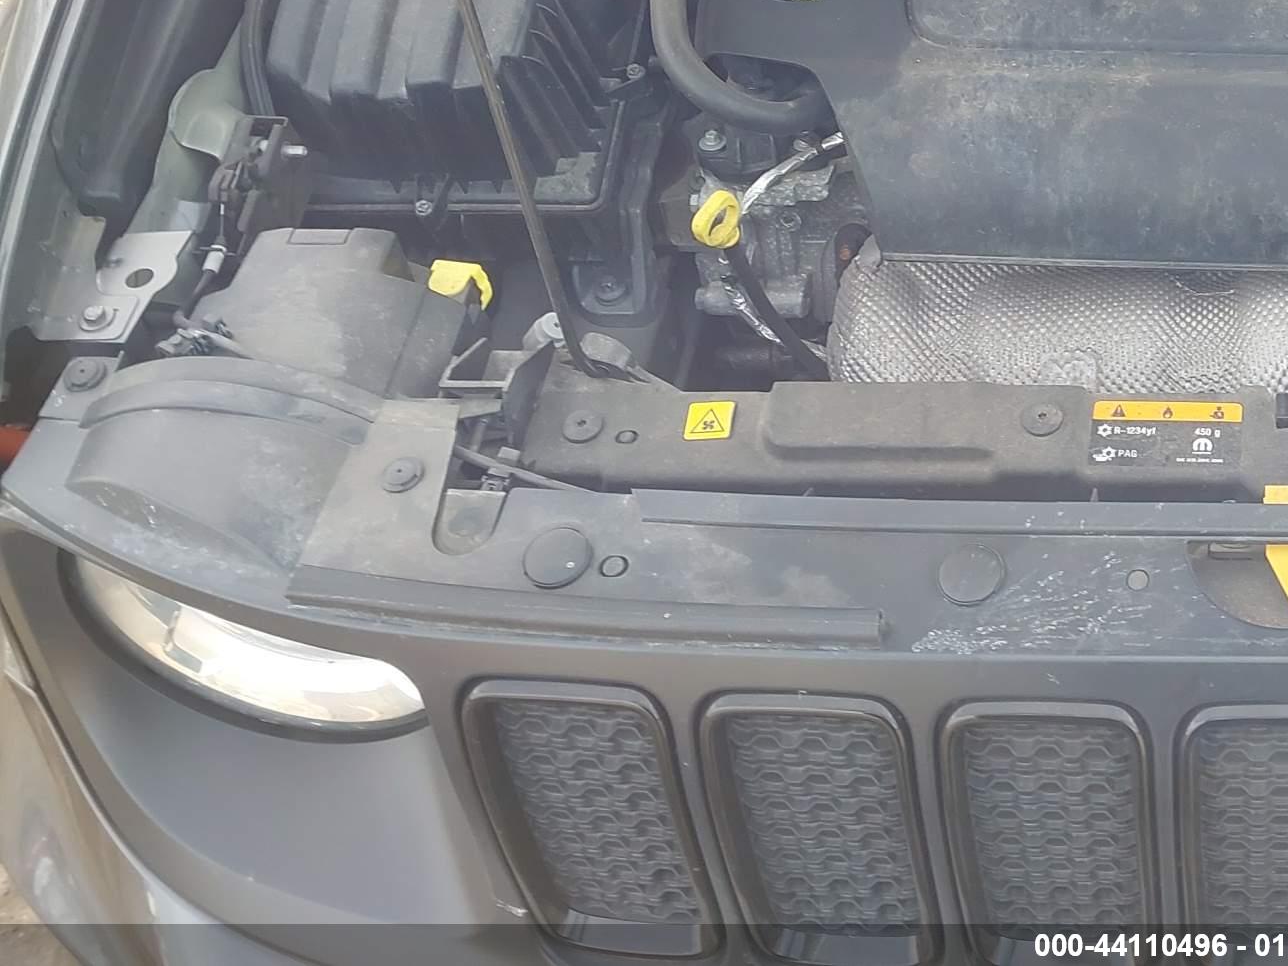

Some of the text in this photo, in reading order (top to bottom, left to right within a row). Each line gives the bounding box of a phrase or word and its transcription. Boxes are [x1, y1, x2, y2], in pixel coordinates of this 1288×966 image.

[1113, 426, 1157, 437] R-1234yf
[1194, 427, 1212, 436] 450
[1118, 449, 1138, 458] PAG
